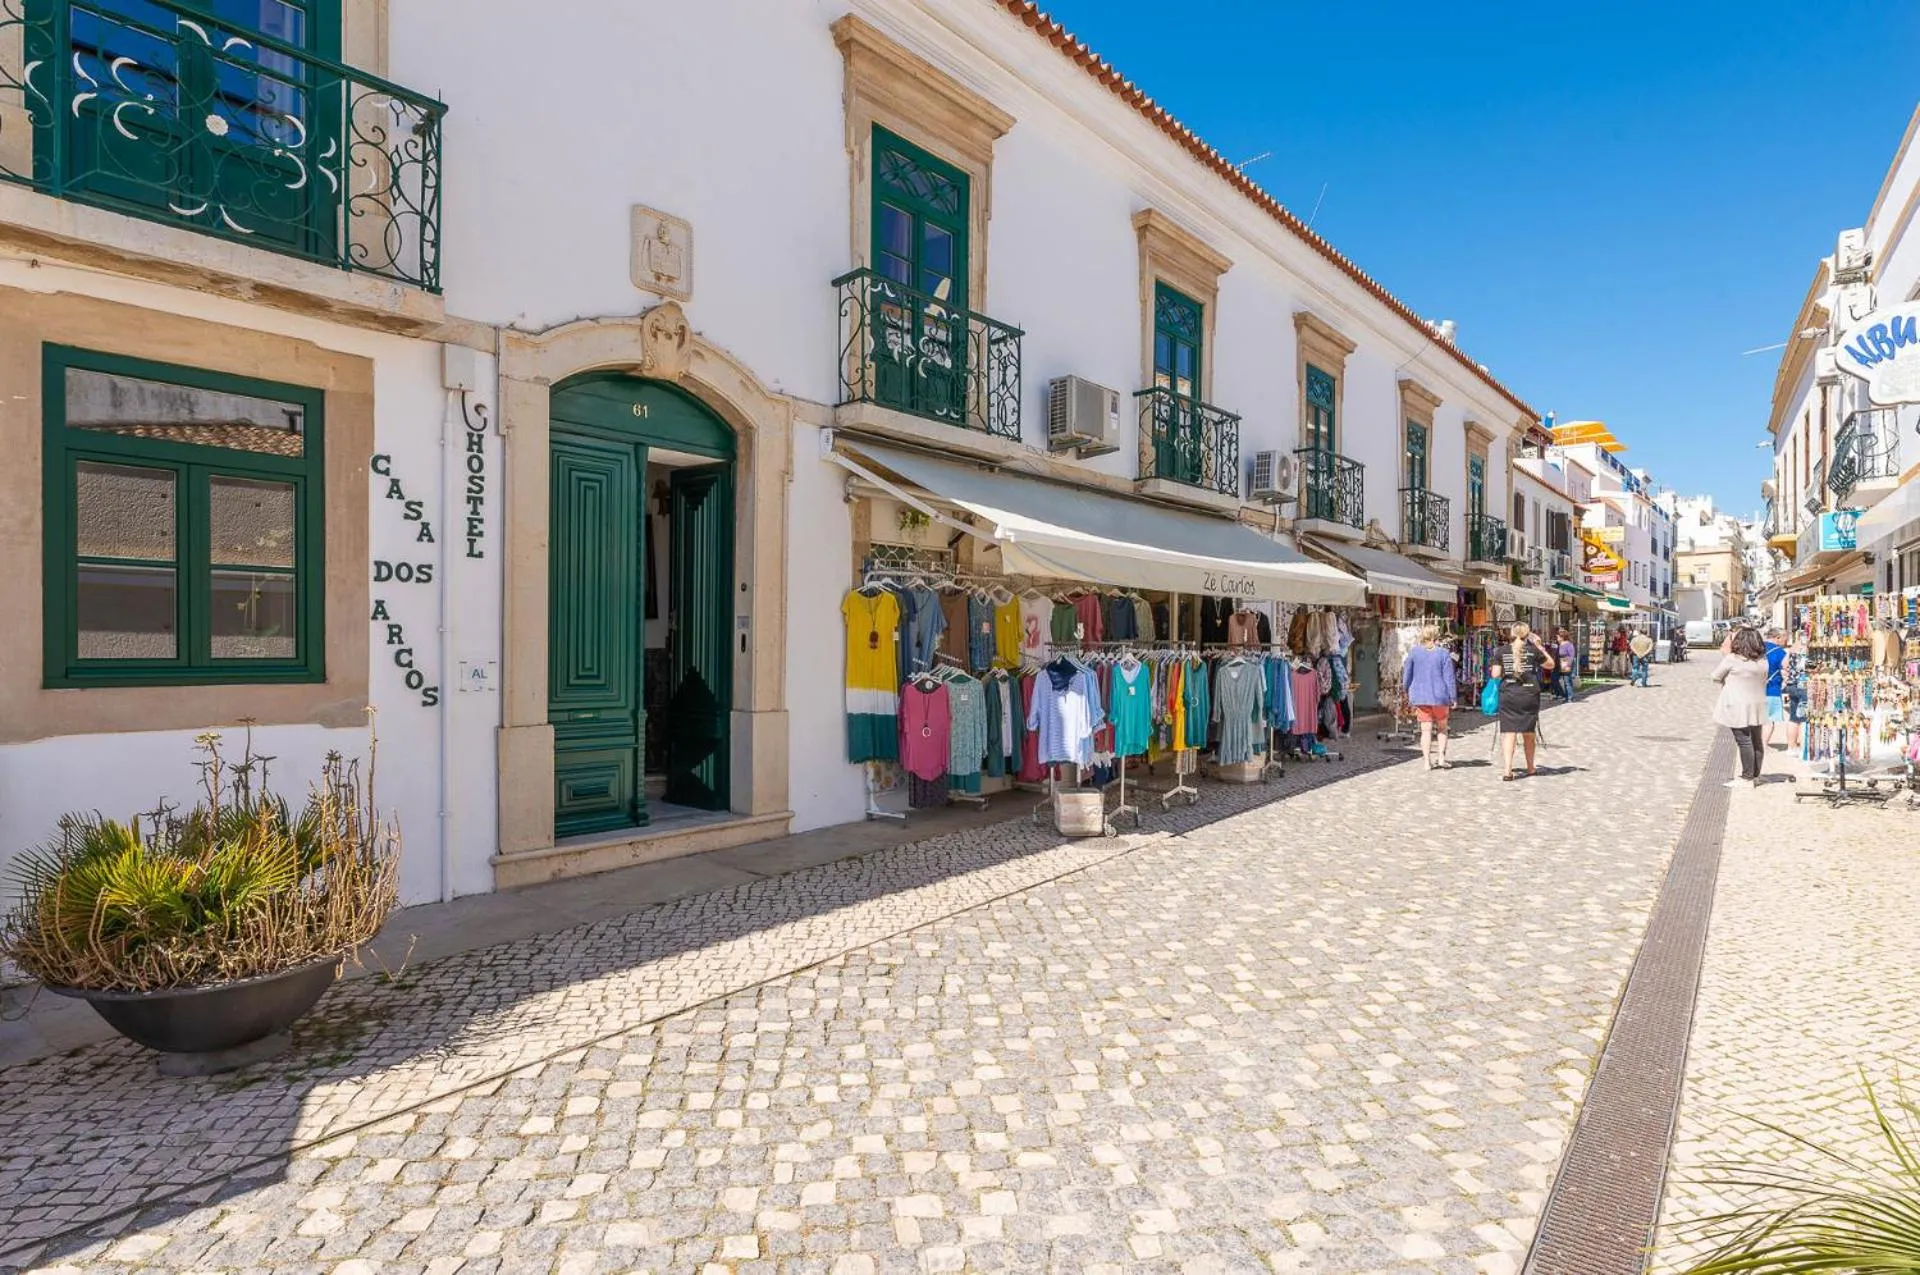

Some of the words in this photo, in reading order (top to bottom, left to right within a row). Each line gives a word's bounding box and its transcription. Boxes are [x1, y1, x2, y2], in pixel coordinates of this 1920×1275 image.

[1843, 315, 1920, 370] ALBU
[633, 403, 648, 419] 61
[370, 454, 435, 543] CASA
[466, 432, 484, 559] HOSTEL
[373, 561, 433, 584] DOS
[1220, 574, 1256, 595] Carlos
[370, 600, 439, 708] ARCOS
[471, 667, 488, 679] AL
